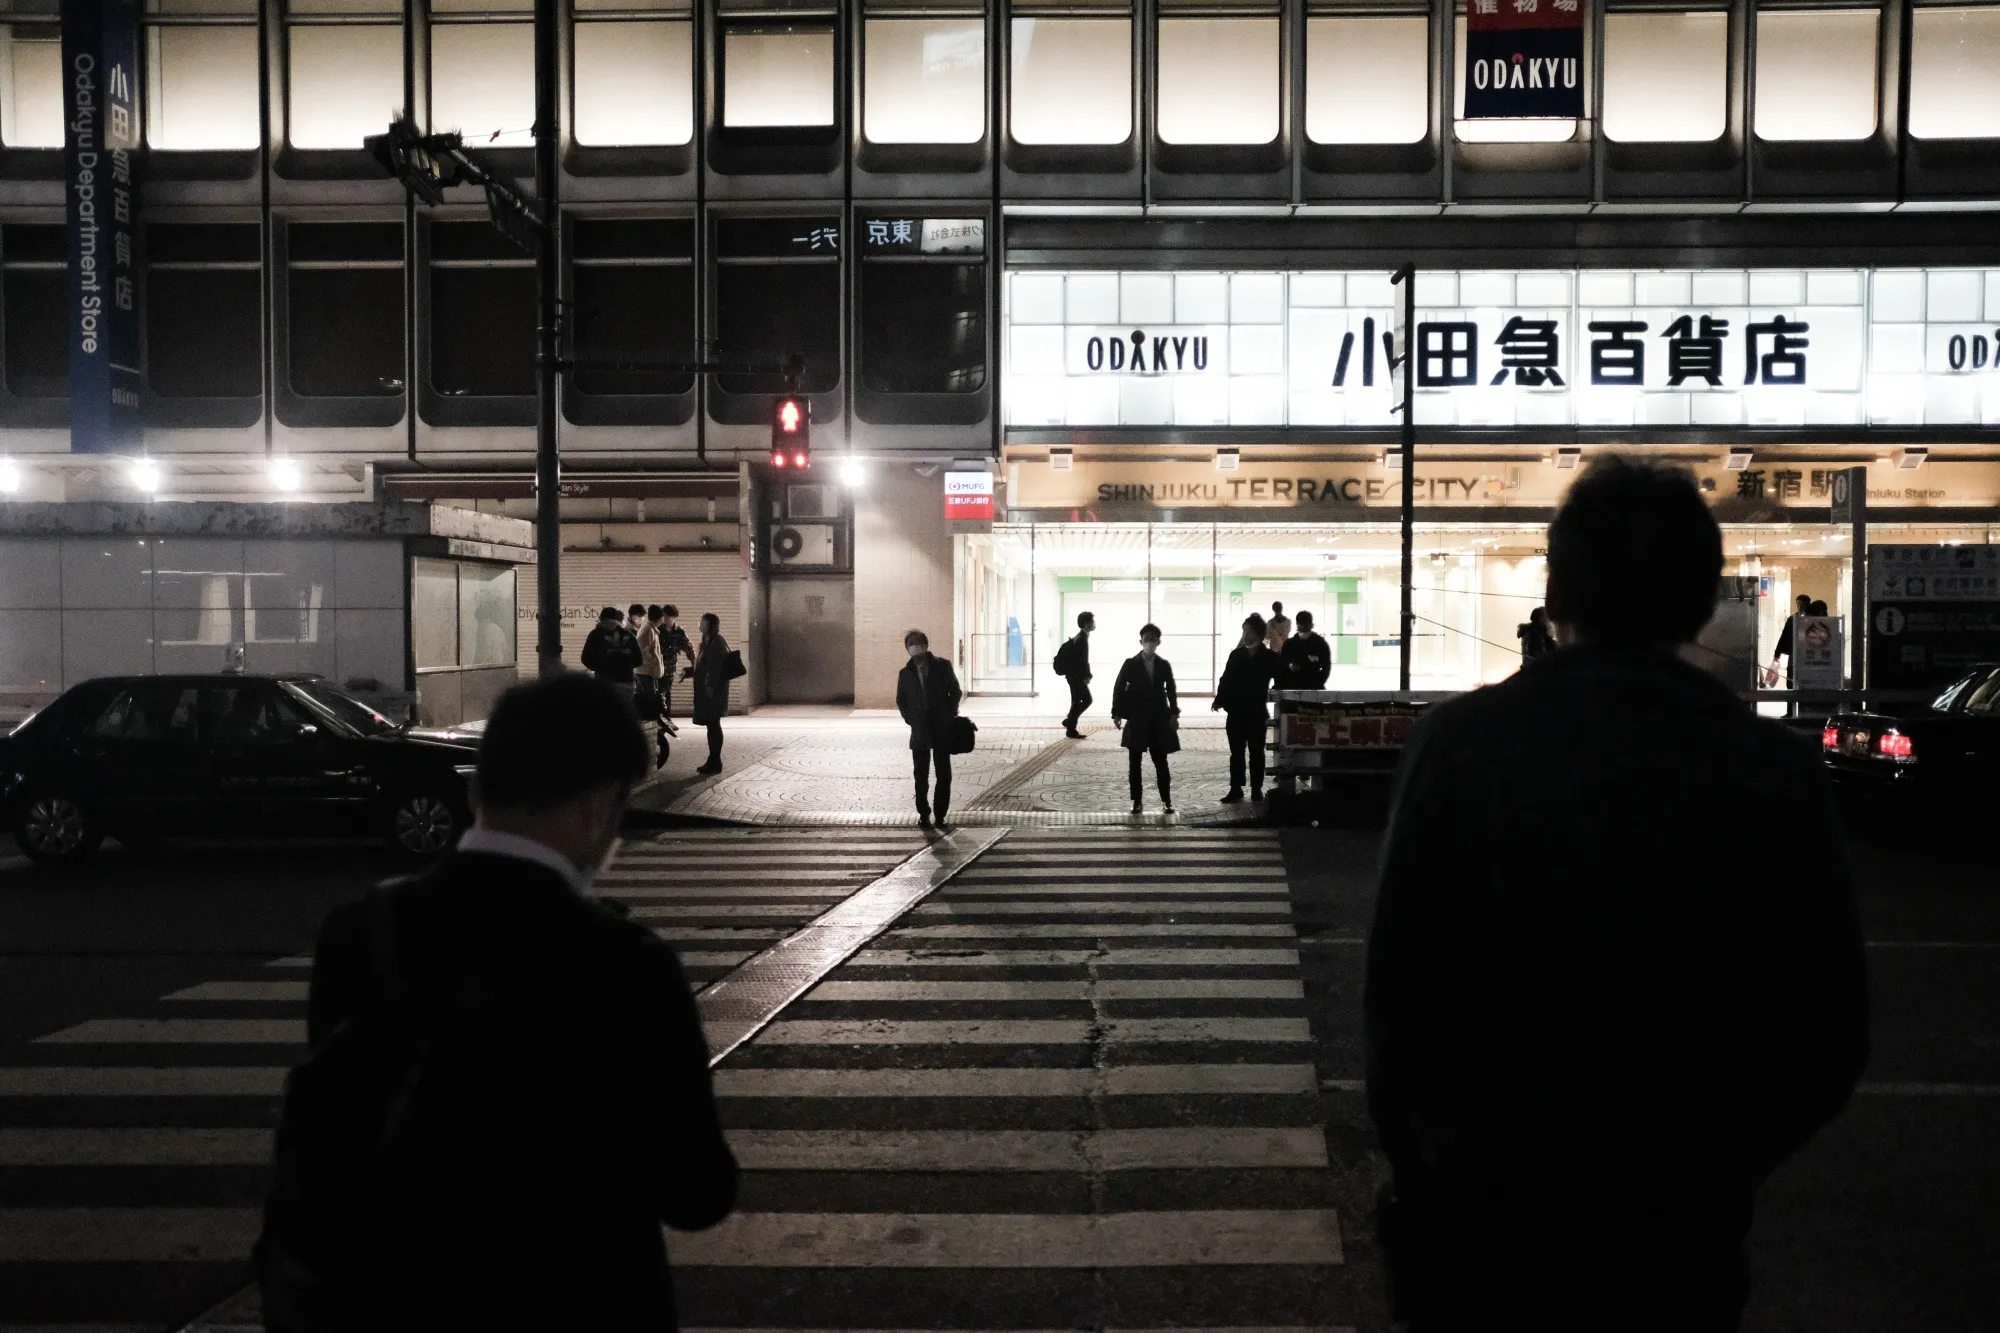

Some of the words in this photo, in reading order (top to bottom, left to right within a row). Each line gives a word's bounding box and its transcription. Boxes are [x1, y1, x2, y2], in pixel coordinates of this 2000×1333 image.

[1474, 54, 1577, 90] ODAKYU
[71, 52, 98, 149] Odakyu
[75, 151, 101, 293] Department
[80, 295, 102, 354] Store
[1087, 329, 1208, 372] ODAKYU
[1331, 314, 1811, 387] 小田急百貨店
[1097, 482, 1218, 502] SHINJUKU
[1225, 476, 1385, 502] TERRACE
[1413, 477, 1479, 501] CITY
[1904, 487, 1946, 499] Station
